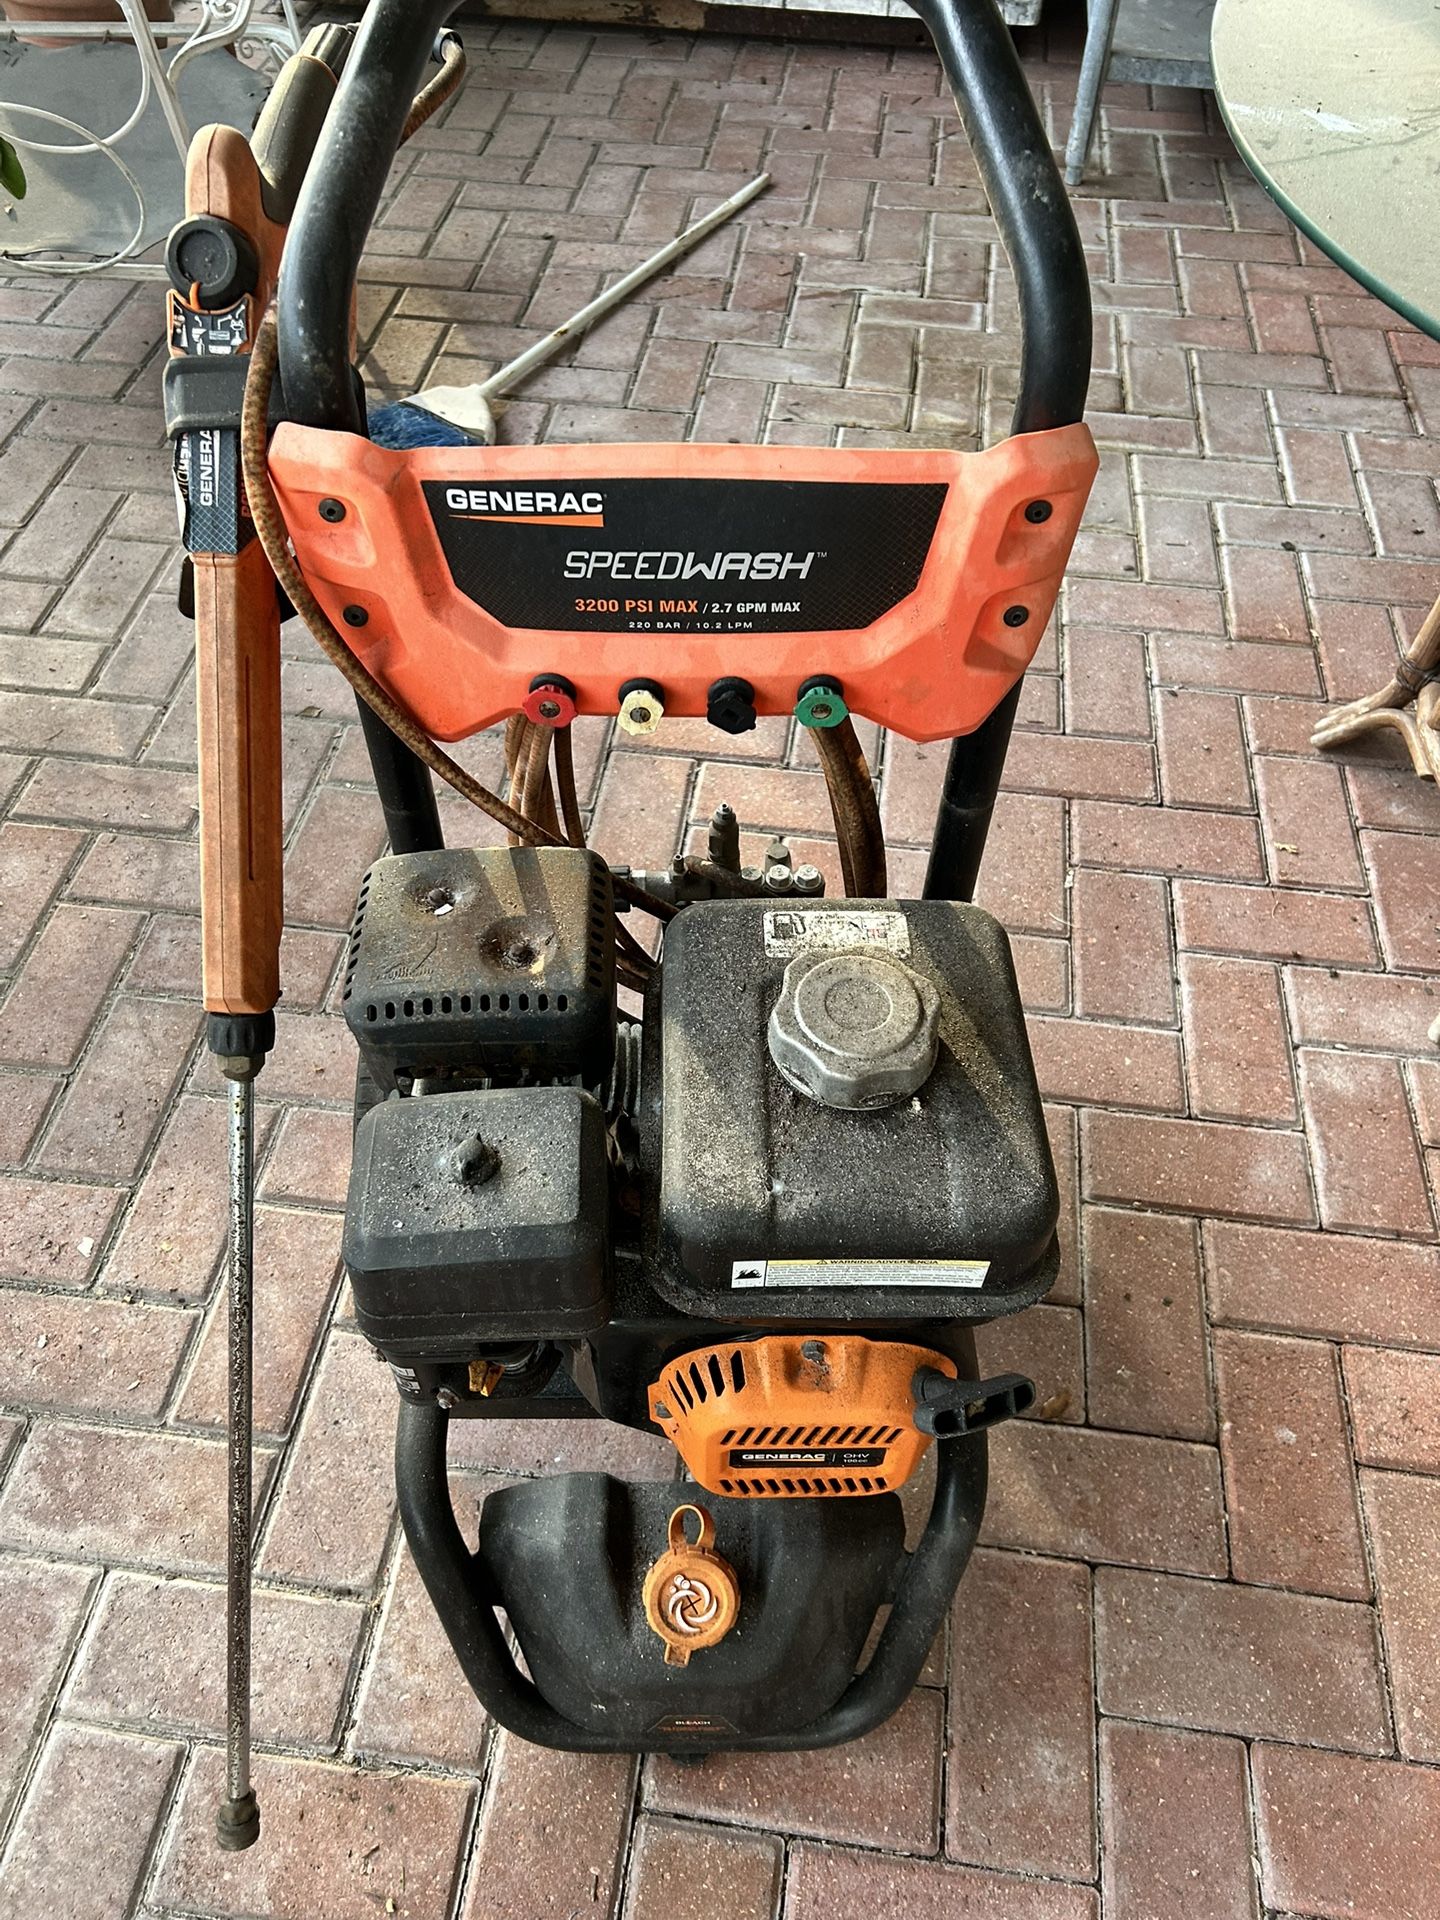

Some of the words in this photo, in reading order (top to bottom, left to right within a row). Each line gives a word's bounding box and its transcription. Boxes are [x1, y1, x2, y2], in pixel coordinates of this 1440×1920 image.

[199, 430, 213, 507] GENERA
[445, 488, 603, 513] GENERAC
[575, 598, 619, 613] 3200
[625, 599, 653, 613] PSI
[659, 600, 698, 613] MAX
[711, 602, 732, 614] 2.7
[736, 602, 767, 614] GPM
[771, 602, 801, 613] MAX
[628, 621, 651, 629] 220
[656, 621, 681, 629] BAR
[696, 621, 722, 629] 10.2
[727, 621, 753, 629] LPM
